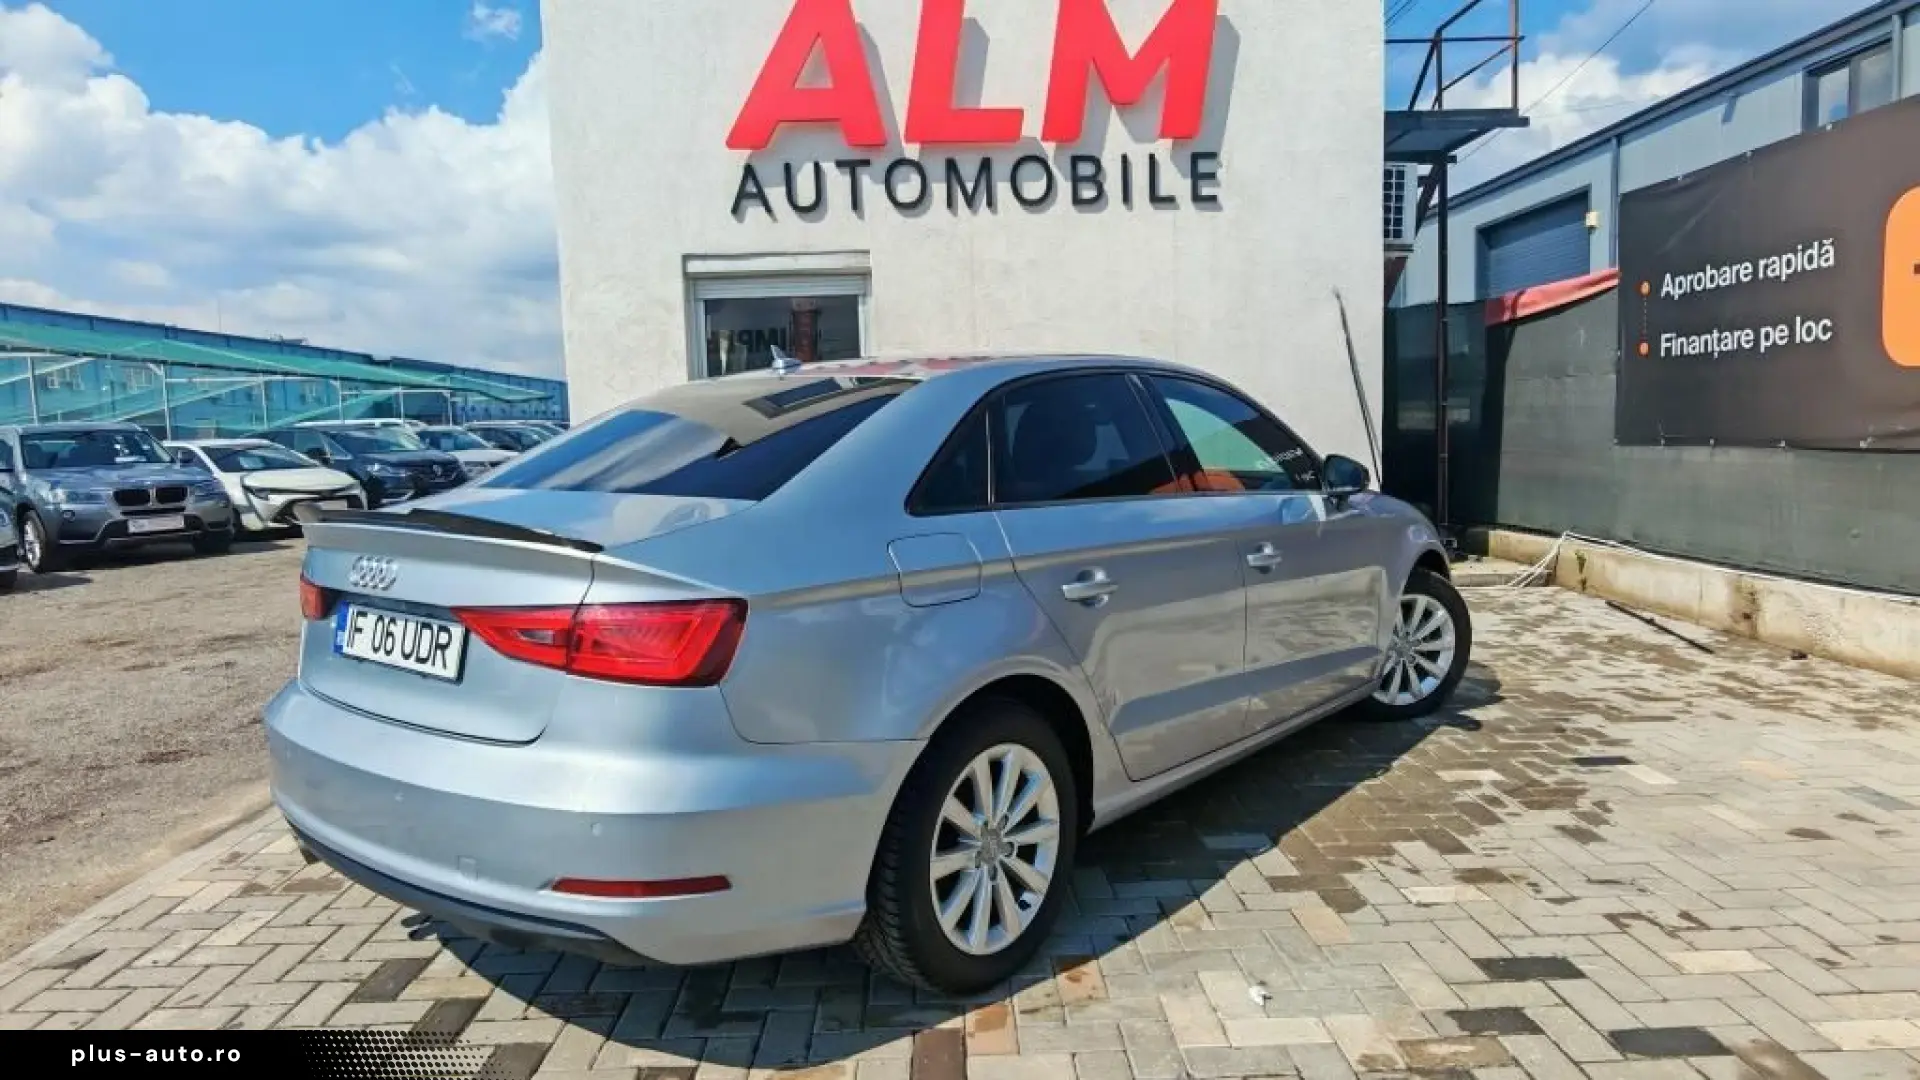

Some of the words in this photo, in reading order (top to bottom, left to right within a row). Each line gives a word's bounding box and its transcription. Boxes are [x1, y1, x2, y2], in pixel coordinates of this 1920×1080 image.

[725, 0, 1219, 150] ALM
[730, 151, 1221, 218] AUTOMOBILE
[1660, 262, 1753, 300] Aprobare
[1758, 238, 1836, 282] rapidă
[1660, 328, 1754, 359] Finanțare
[1759, 322, 1790, 353] pe
[1795, 316, 1833, 344] loc
[346, 609, 368, 649] IF
[371, 614, 397, 657] 06
[401, 618, 453, 670] UDR
